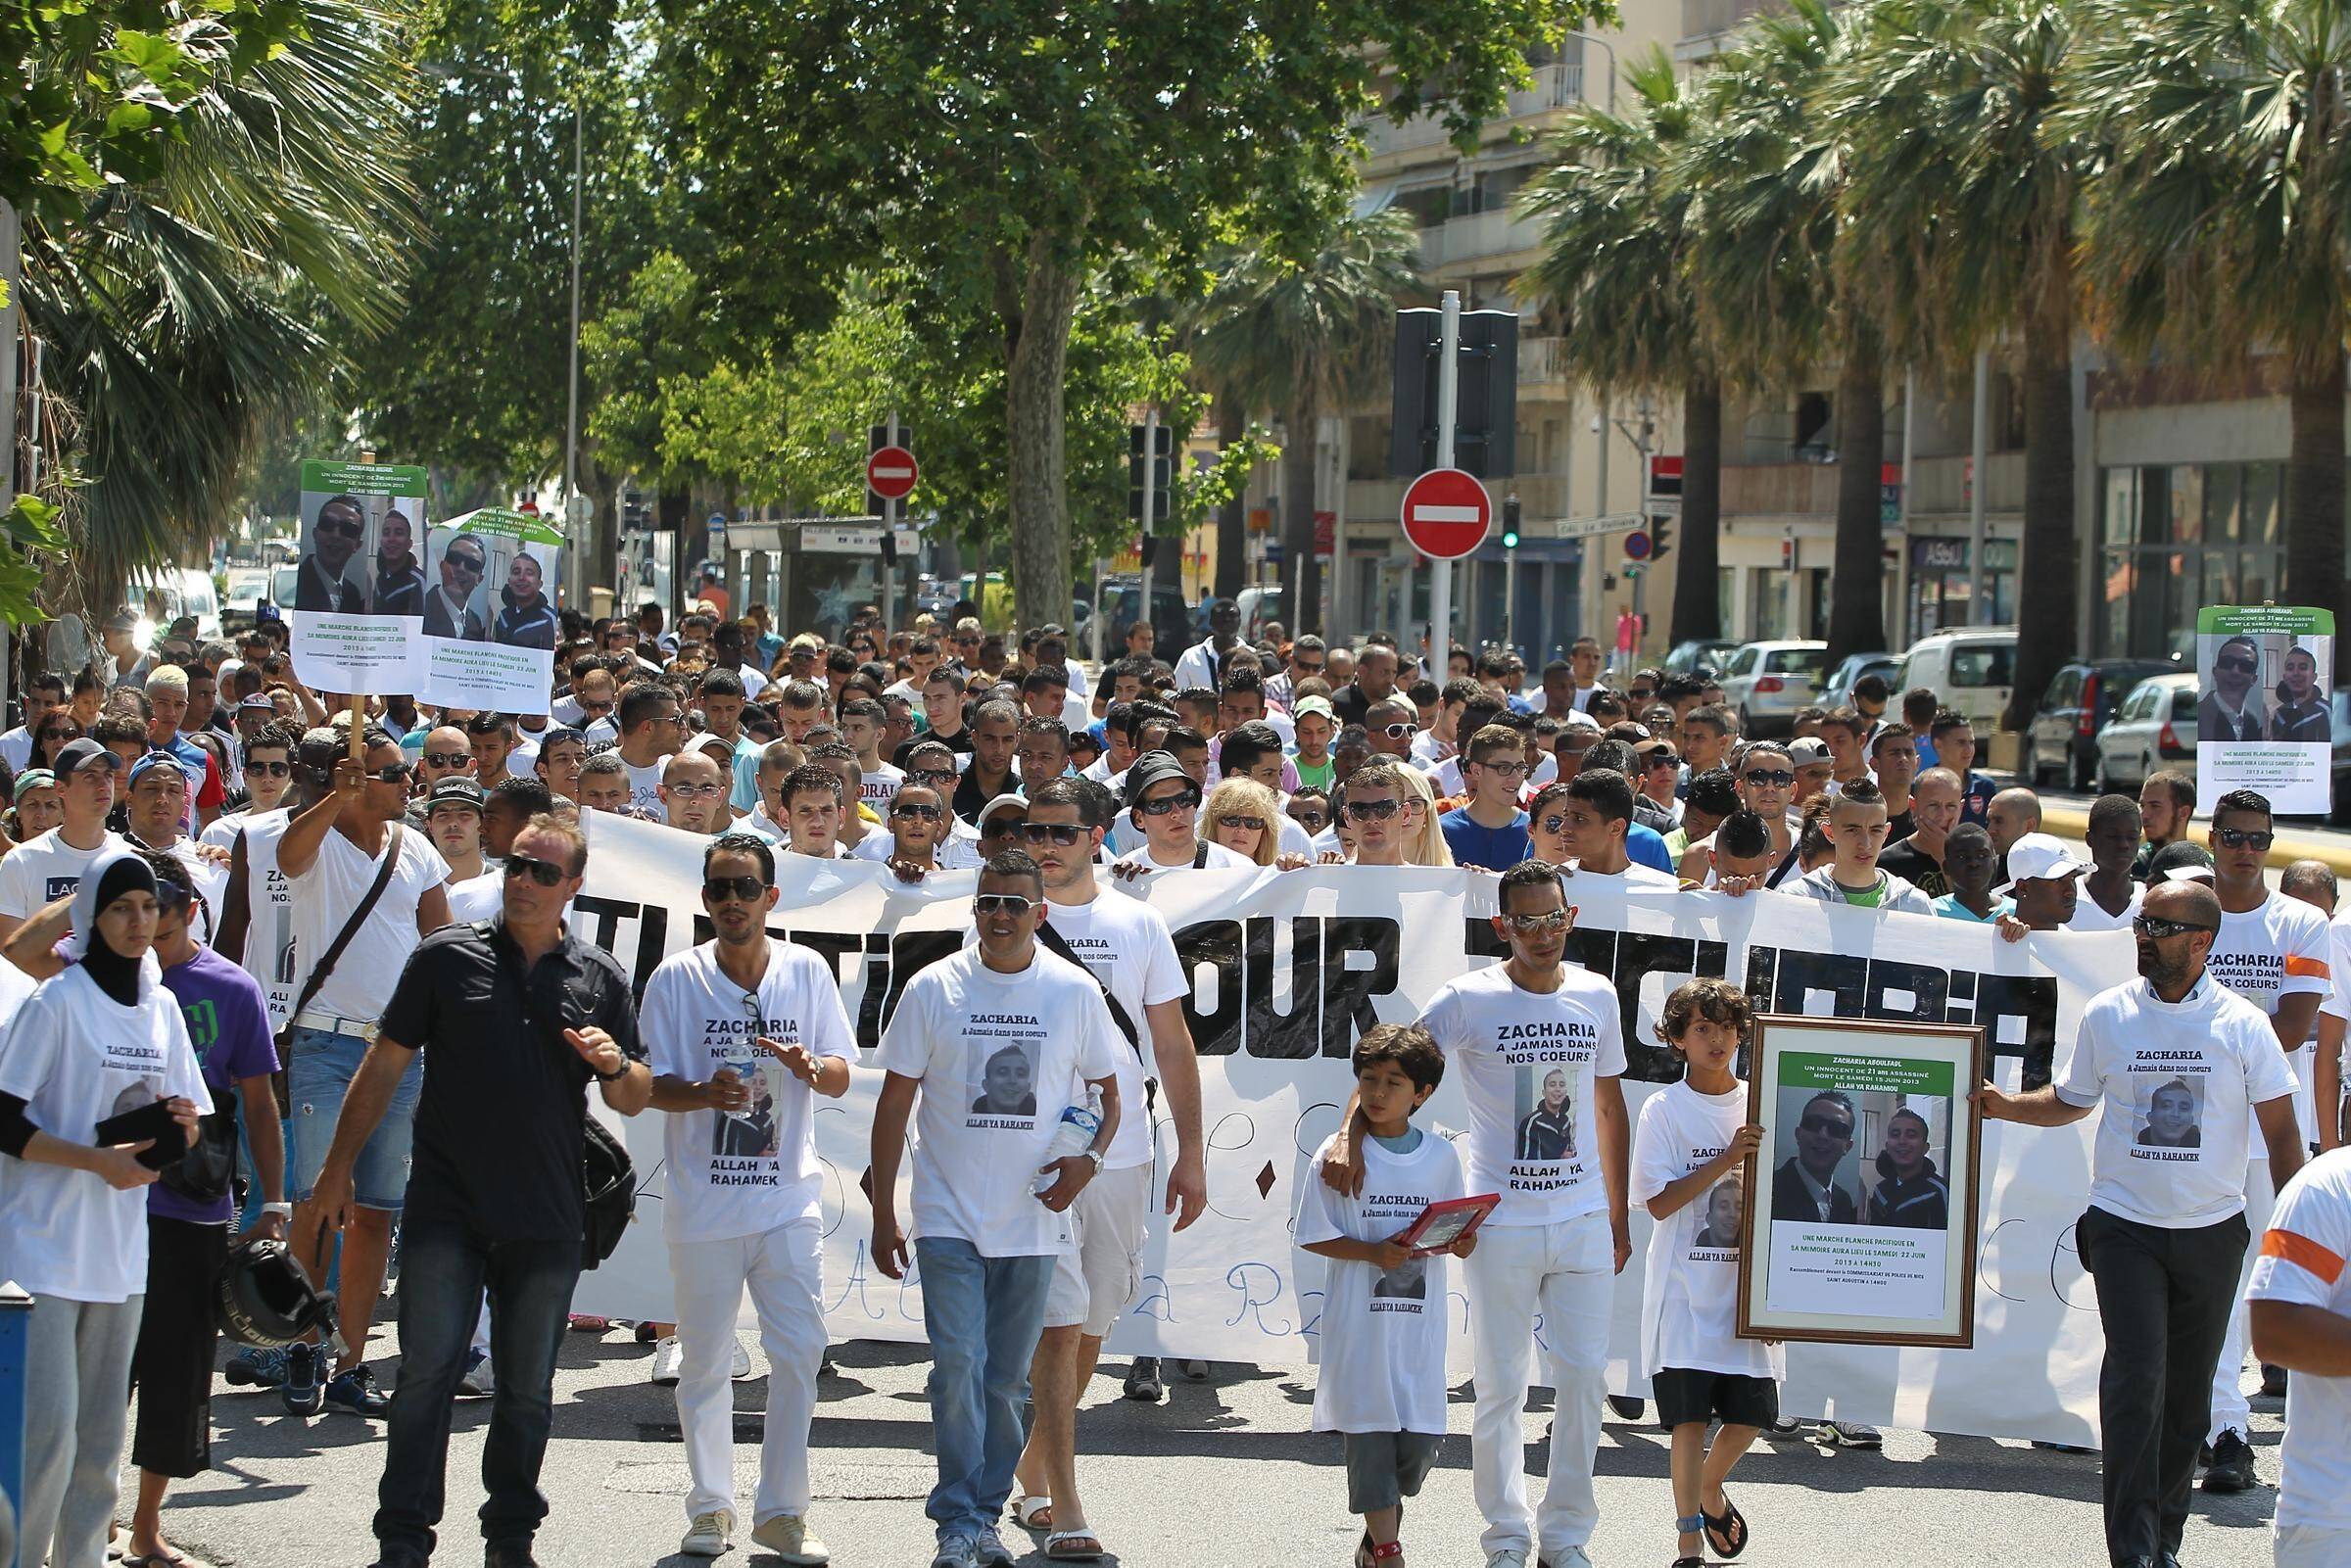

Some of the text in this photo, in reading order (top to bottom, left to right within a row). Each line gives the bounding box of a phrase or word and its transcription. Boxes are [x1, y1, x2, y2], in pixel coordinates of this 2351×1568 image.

[2205, 954, 2283, 968] ZACHARIA
[2235, 979, 2279, 989] COEURS
[971, 1015, 1038, 1024] ZACHARIA
[1498, 1023, 1596, 1039] ZACHARIA
[704, 1036, 712, 1045] A
[1496, 1040, 1597, 1052] A JAMAIS DANS
[1507, 1052, 1590, 1064] NOS COEURS
[2135, 1051, 2203, 1060] ZACHARIA
[966, 1118, 1033, 1130] ALLAH YA RAHAMEK
[2131, 1149, 2150, 1159] ALLAH
[2162, 1153, 2199, 1162] RAHAMEK
[710, 1160, 758, 1170] ALLAH
[1510, 1164, 1583, 1176] ALLAH YA
[1712, 1253, 1719, 1261] YA
